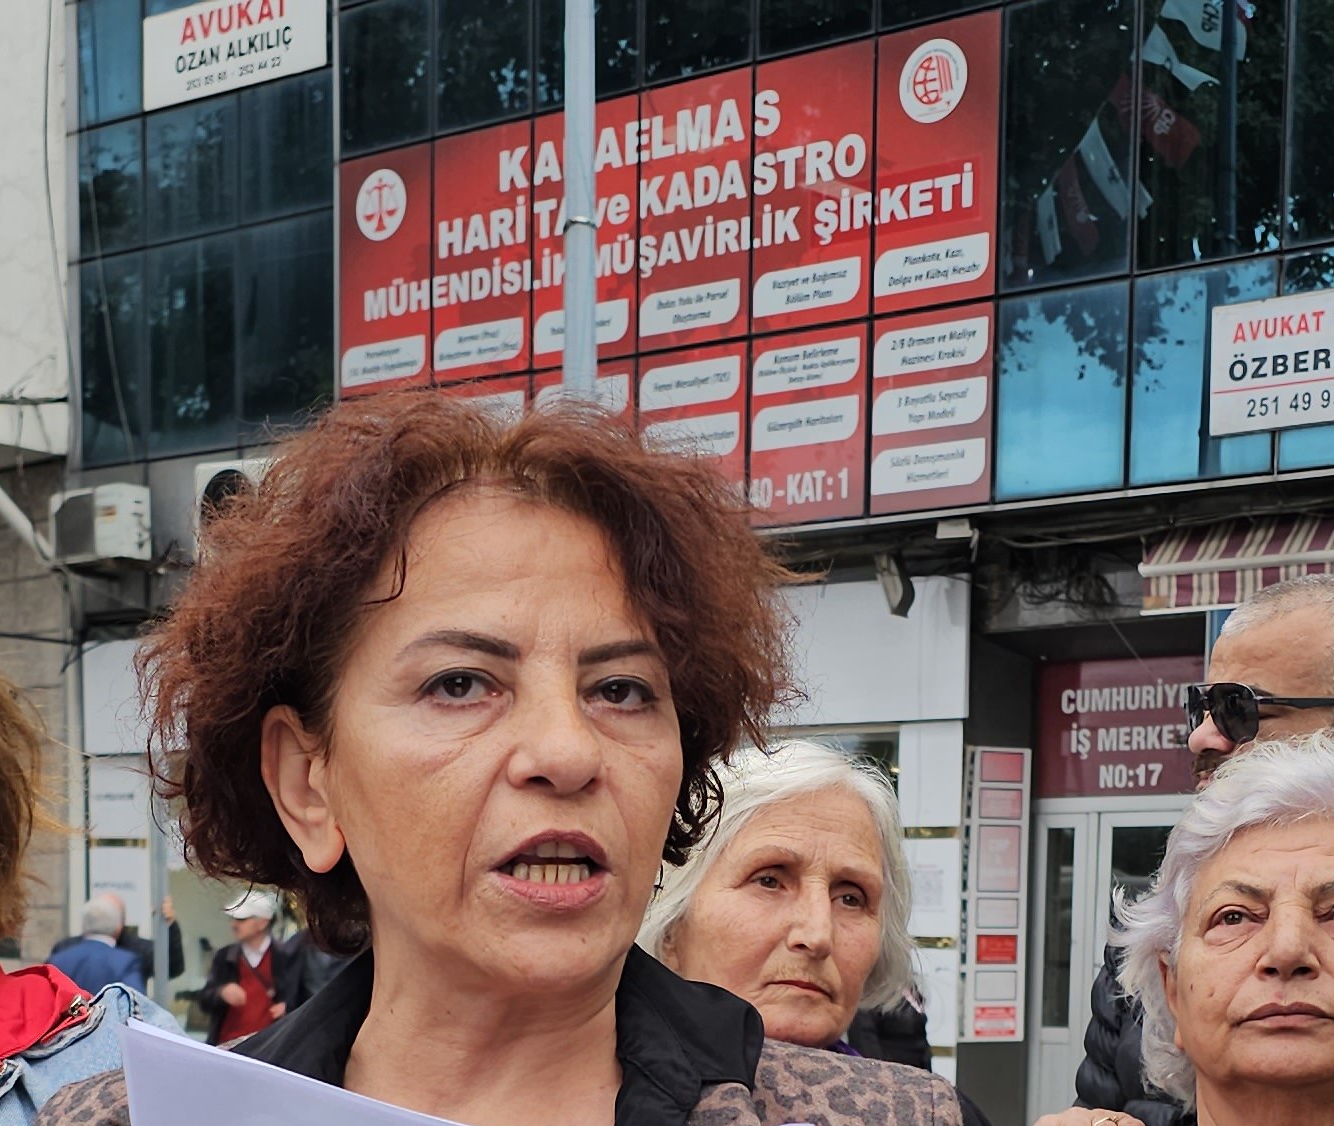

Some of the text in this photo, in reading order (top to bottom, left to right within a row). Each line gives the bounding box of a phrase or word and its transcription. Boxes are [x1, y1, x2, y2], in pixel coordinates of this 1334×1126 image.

[175, 25, 293, 74] OZAN ALKILIÇ
[499, 90, 781, 193] KAAELMAS
[639, 133, 866, 219] KADASTRO
[813, 161, 974, 246] ŞİRKETİ
[1233, 311, 1325, 344] AVUKAT
[1246, 396, 1279, 418] 251
[1289, 392, 1312, 413] 49
[1061, 678, 1189, 714] CUMHURİYE
[1070, 722, 1187, 760] İŞ MERKEZ
[1099, 763, 1163, 789] NO:17
